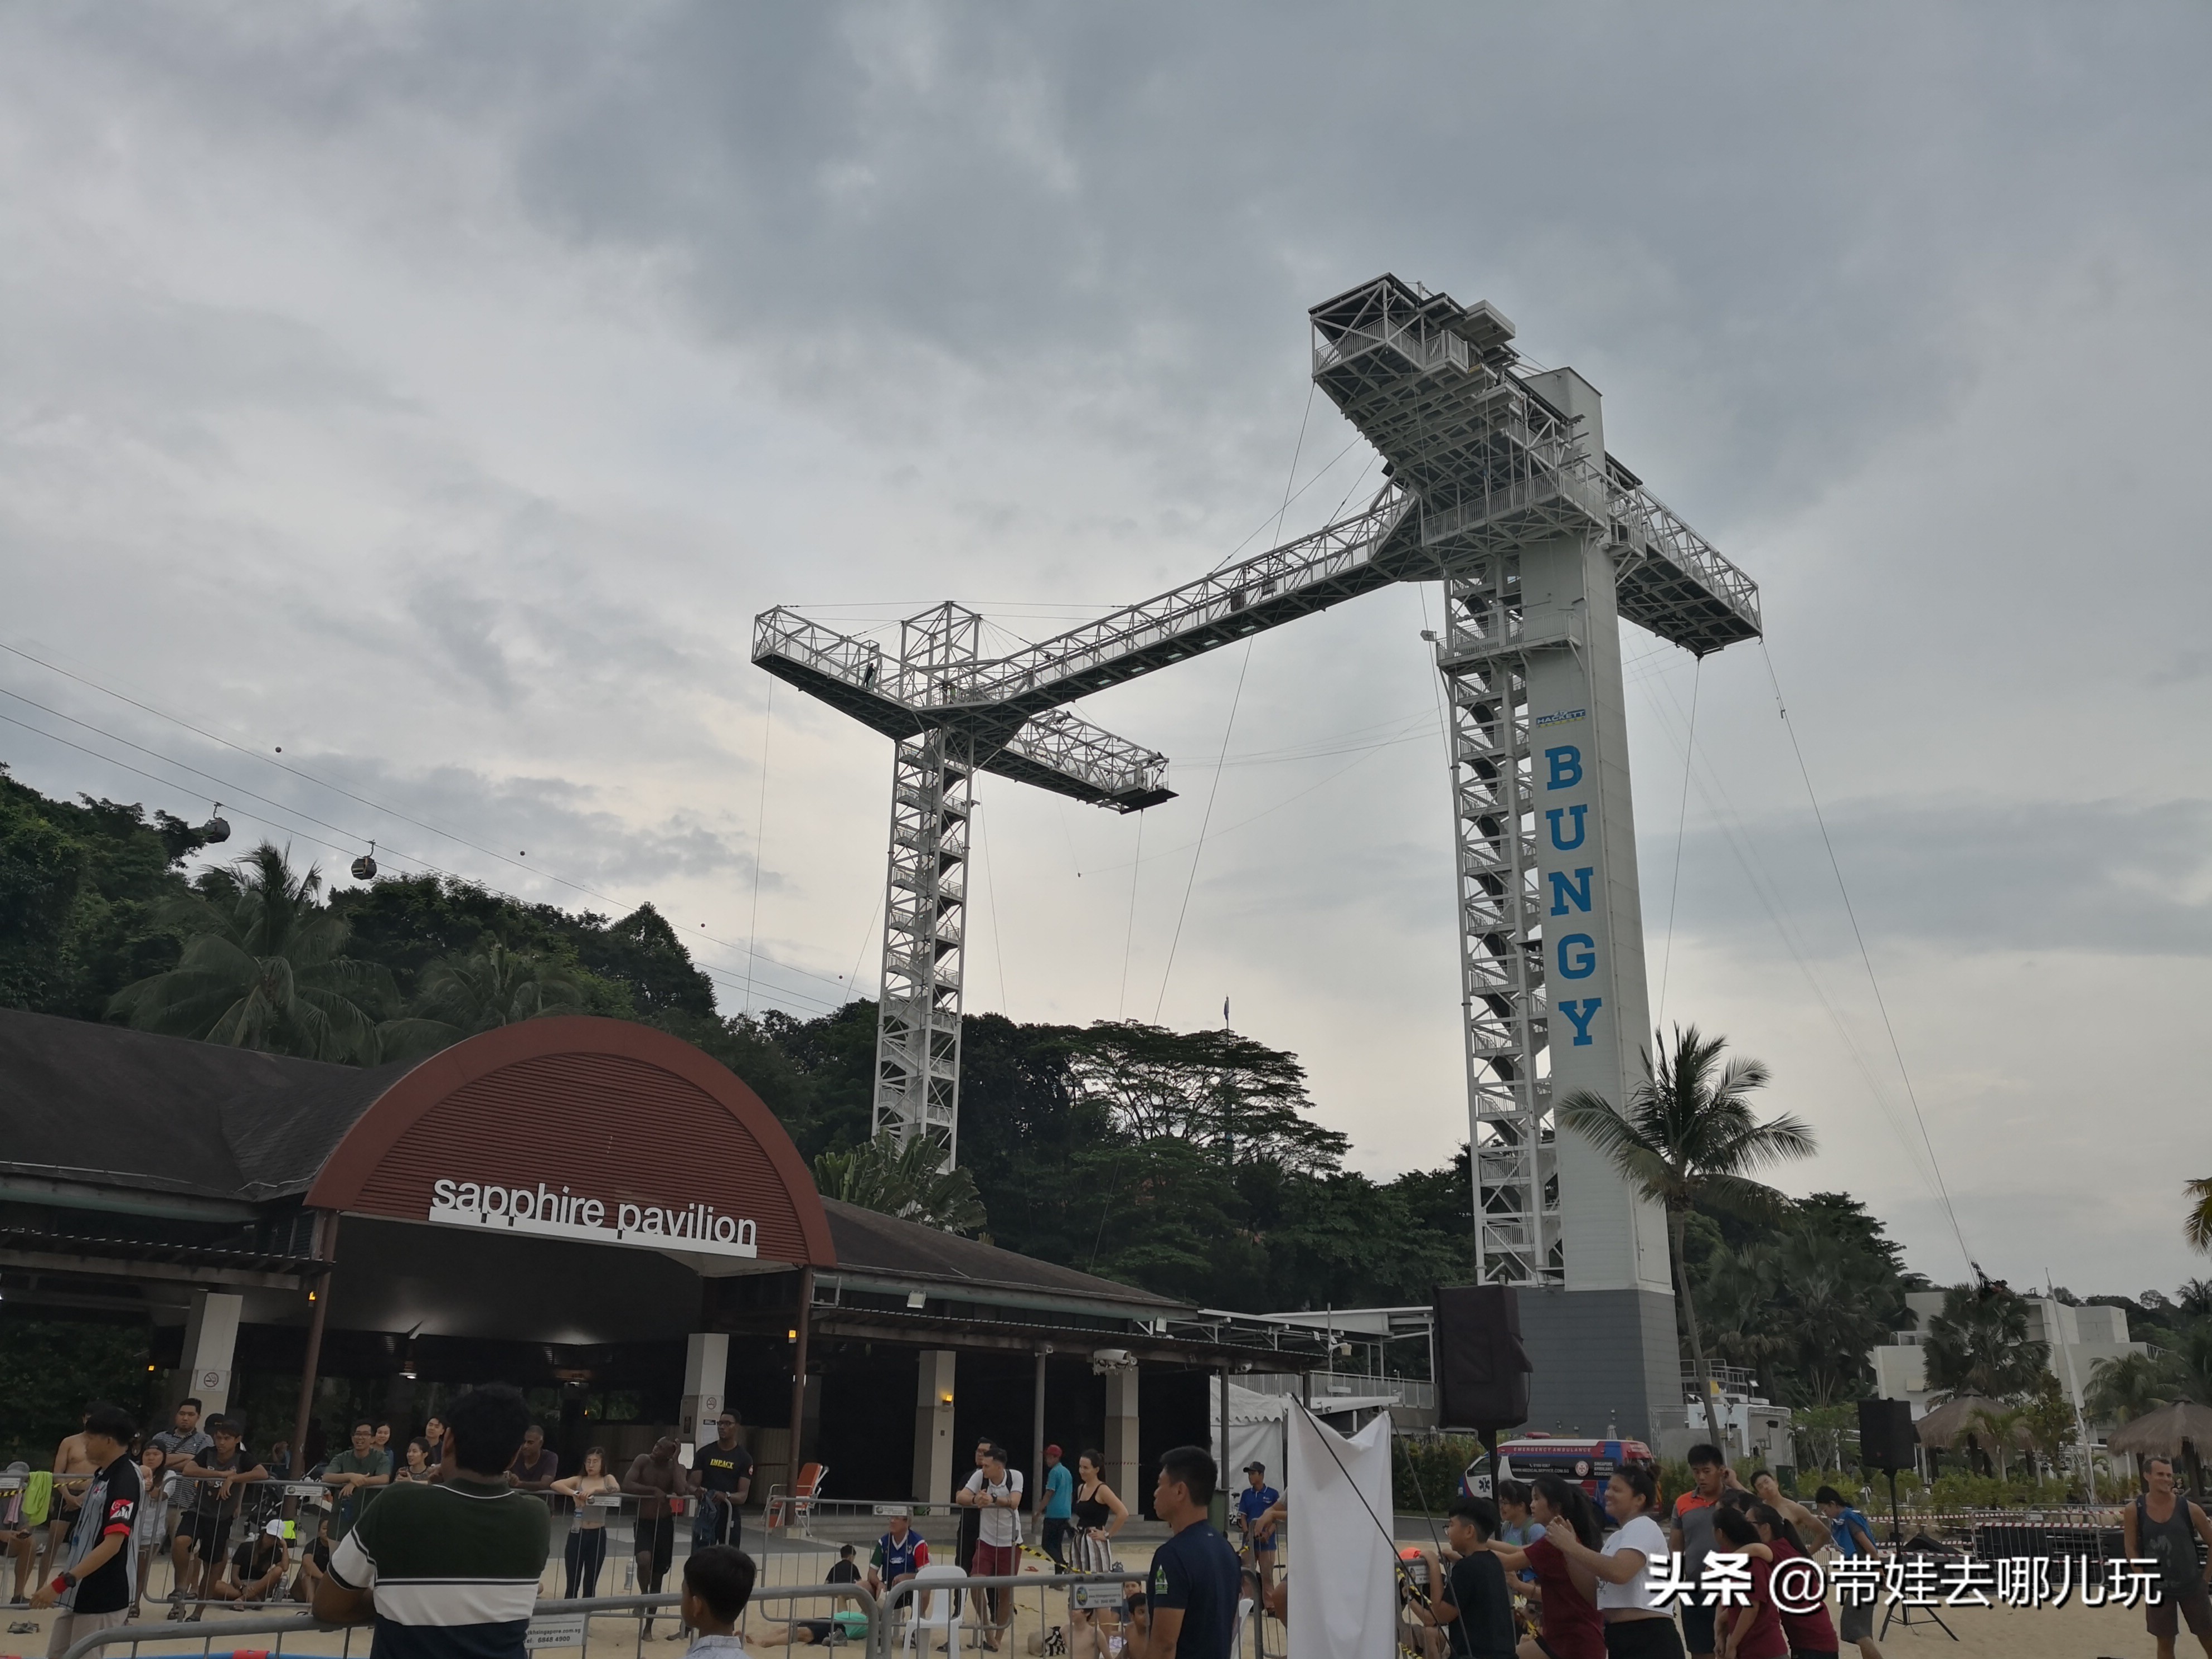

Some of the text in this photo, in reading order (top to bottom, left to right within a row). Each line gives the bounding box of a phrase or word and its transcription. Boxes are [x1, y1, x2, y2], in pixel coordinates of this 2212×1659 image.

[1537, 710, 1585, 724] HACKETT
[1545, 745, 1602, 1046] BUNGY
[431, 1178, 758, 1246] sapphire pavilion
[710, 1458, 734, 1469] IMPACT
